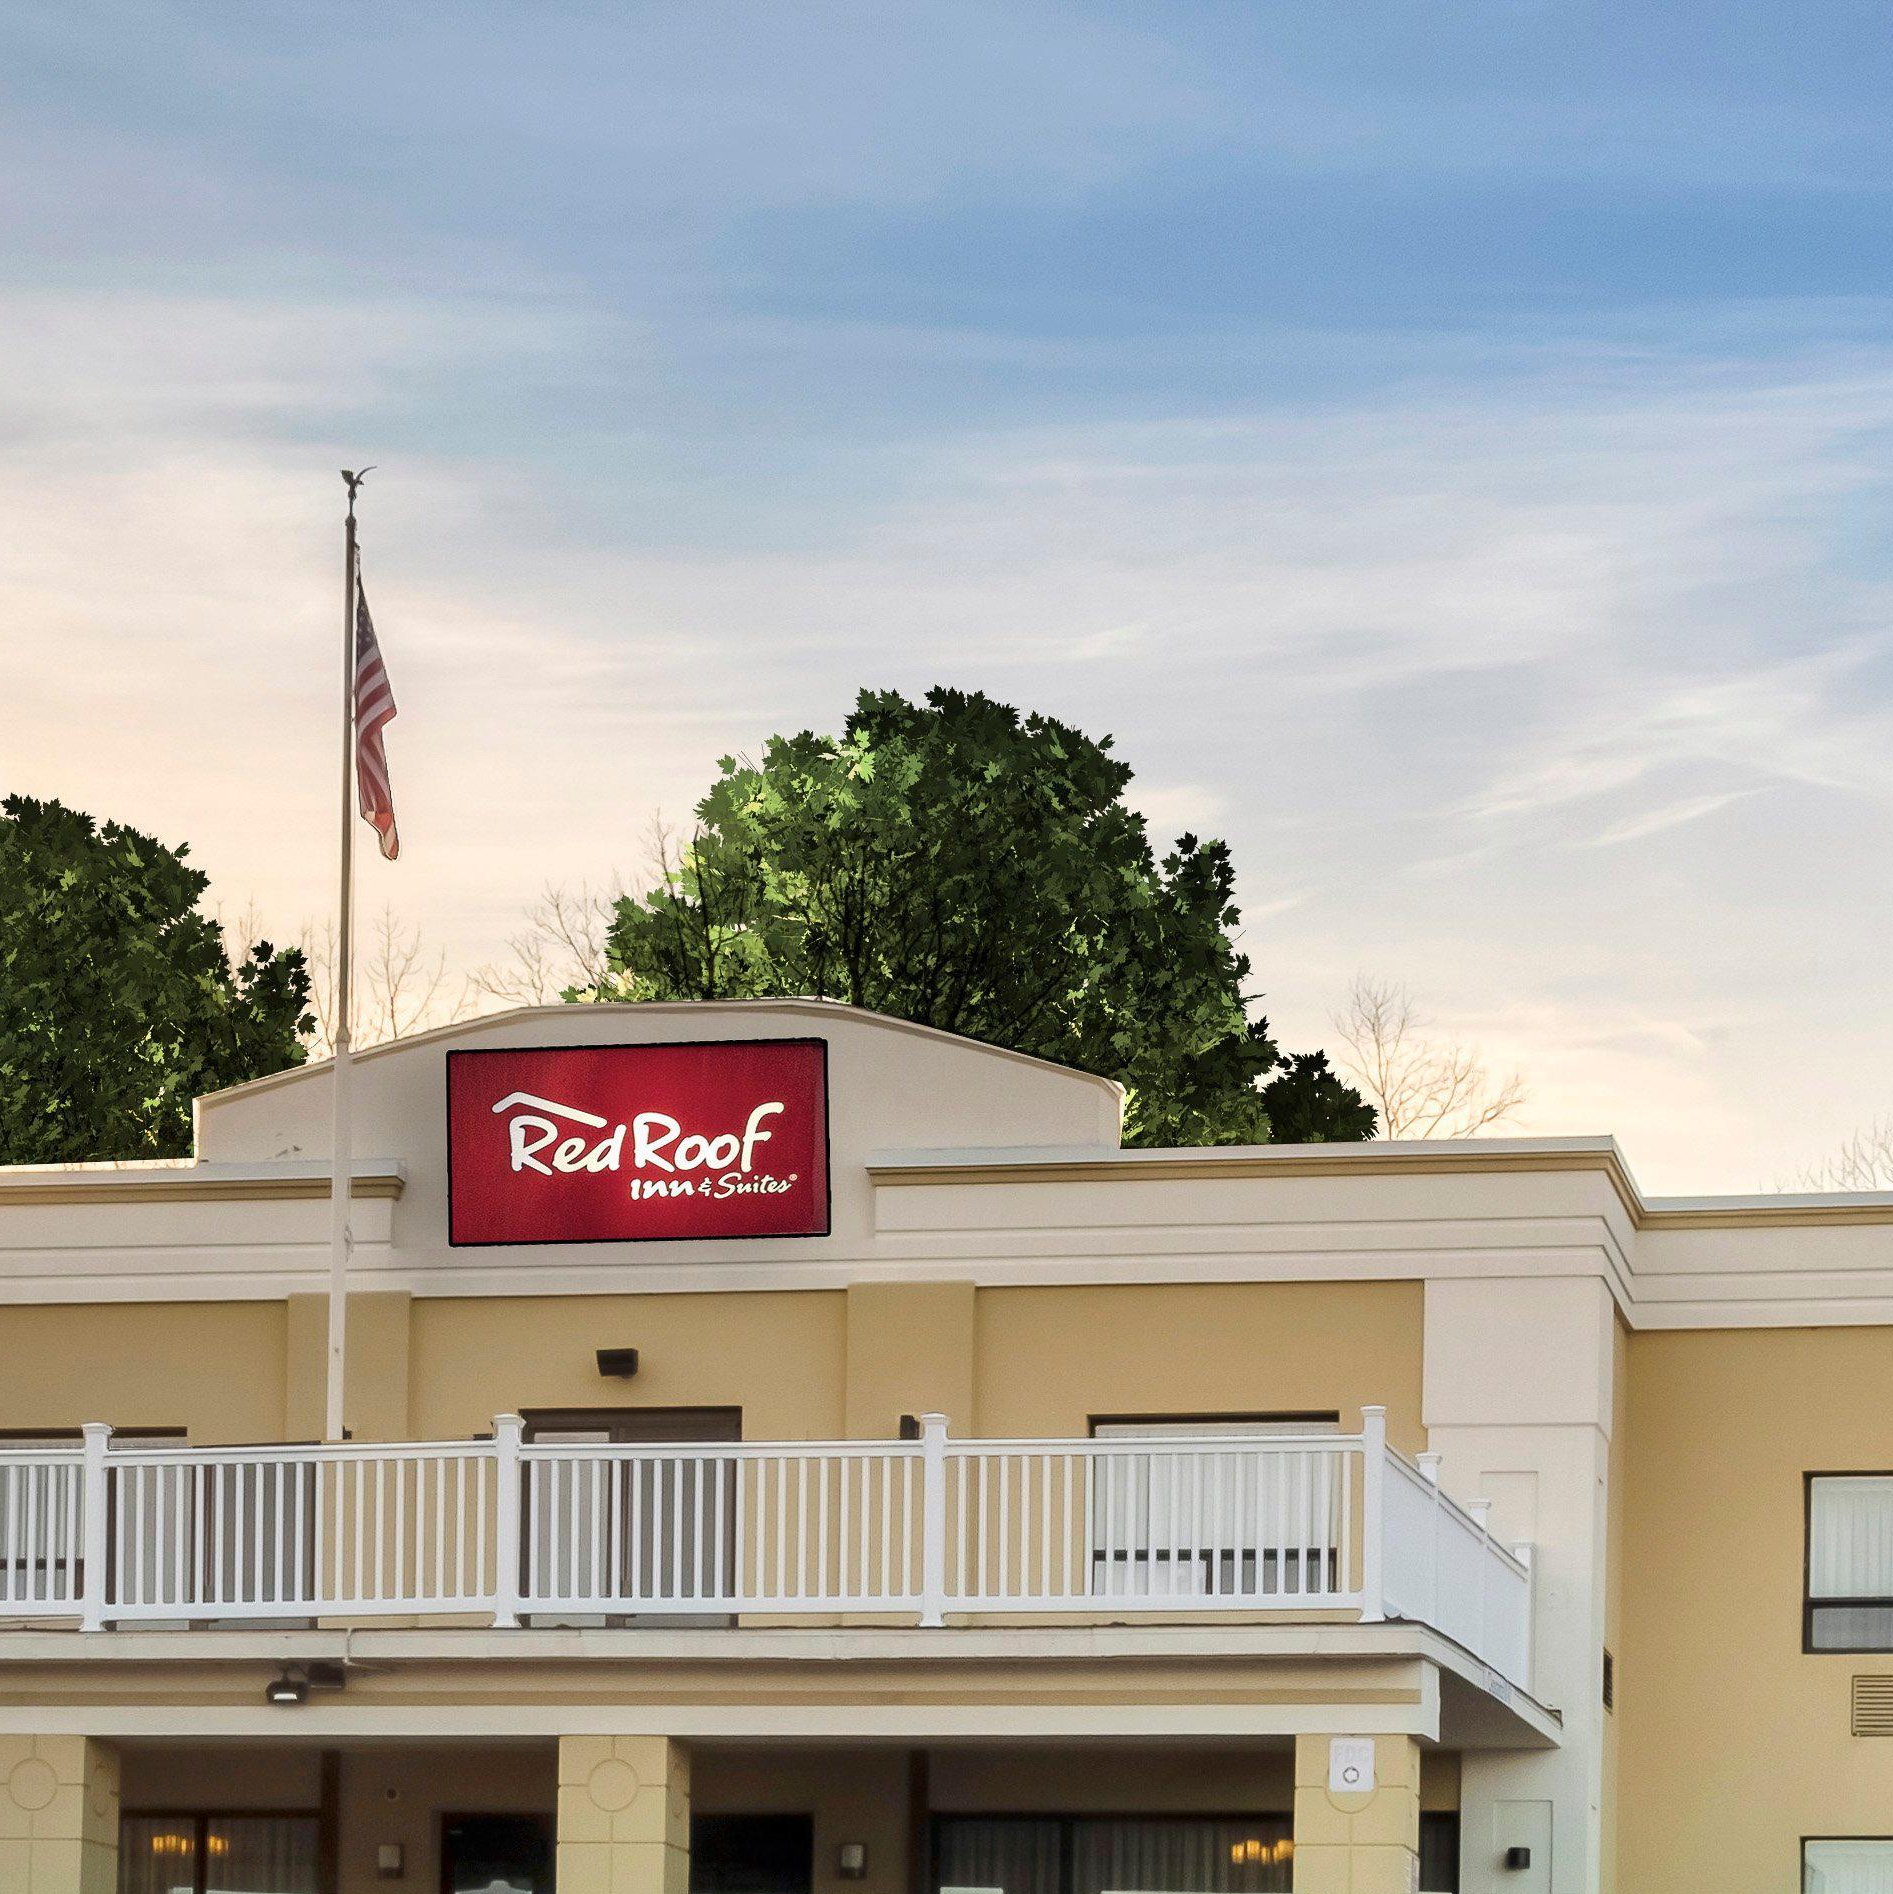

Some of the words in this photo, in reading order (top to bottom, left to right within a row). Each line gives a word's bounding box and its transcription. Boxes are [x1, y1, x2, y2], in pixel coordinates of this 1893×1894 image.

[509, 1115, 627, 1176] Red
[633, 1102, 785, 1173] Roof
[631, 1179, 695, 1200] Inn
[698, 1177, 712, 1197] &
